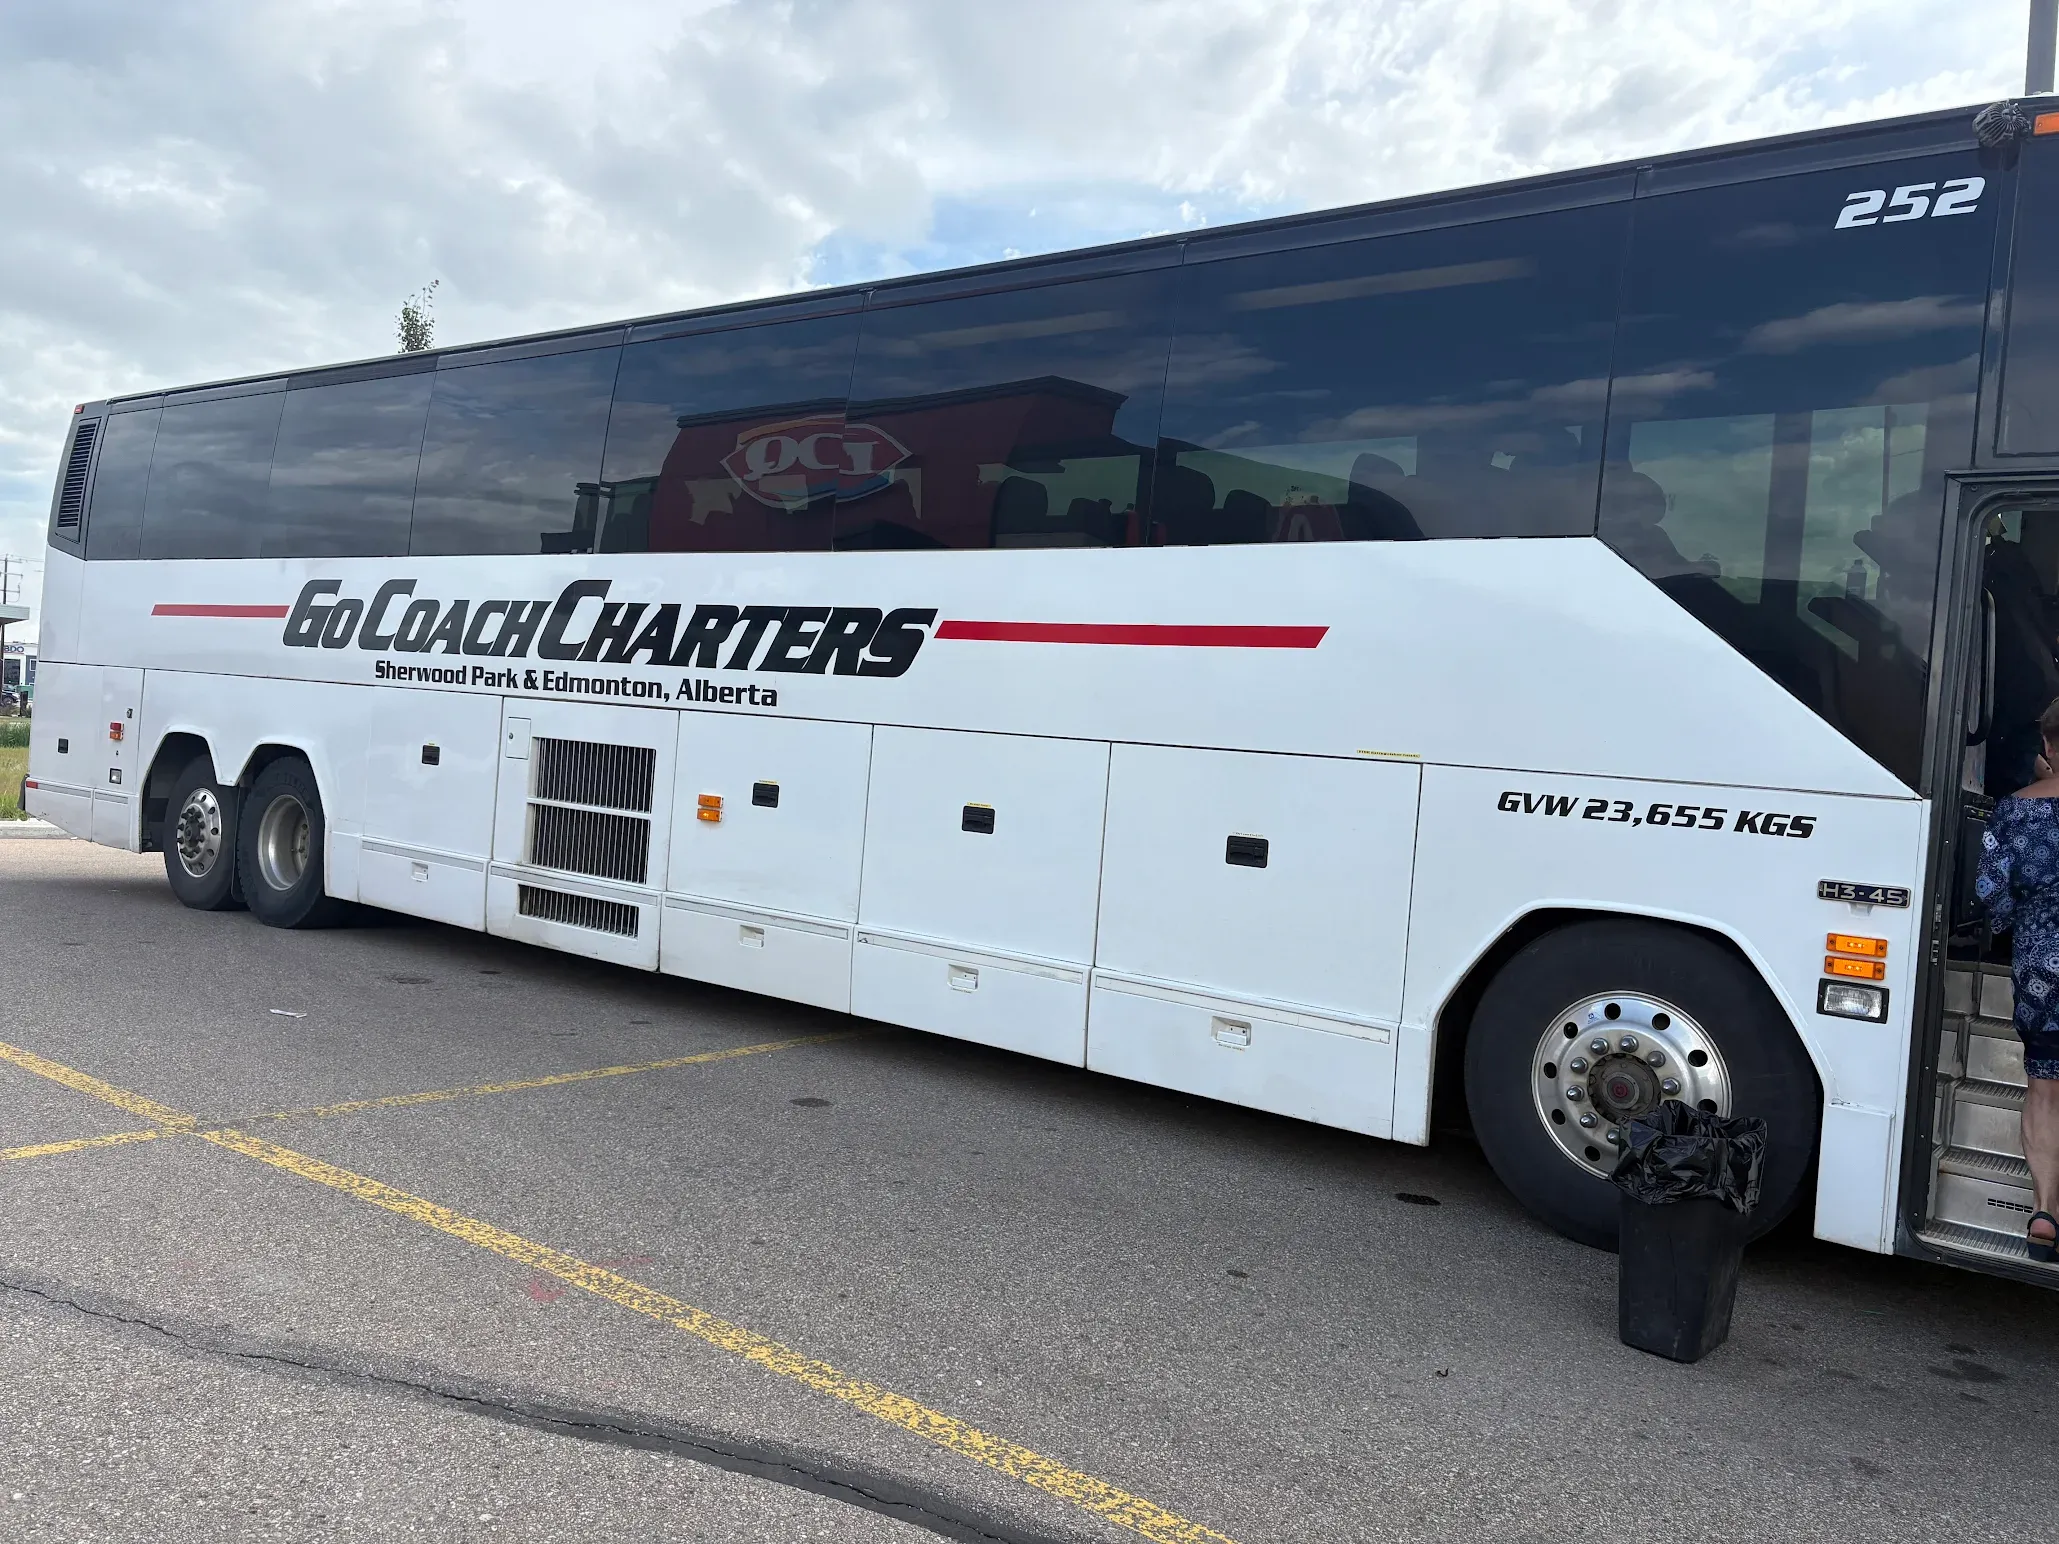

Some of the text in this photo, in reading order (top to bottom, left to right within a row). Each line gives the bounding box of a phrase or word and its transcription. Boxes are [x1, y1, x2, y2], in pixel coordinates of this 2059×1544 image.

[1835, 177, 1985, 229] 252
[375, 661, 778, 706] Sherwood Park & Edmonton, Alberta
[1498, 791, 1817, 838] GVW 23,655 KGS
[1822, 882, 1903, 905] H3-45
